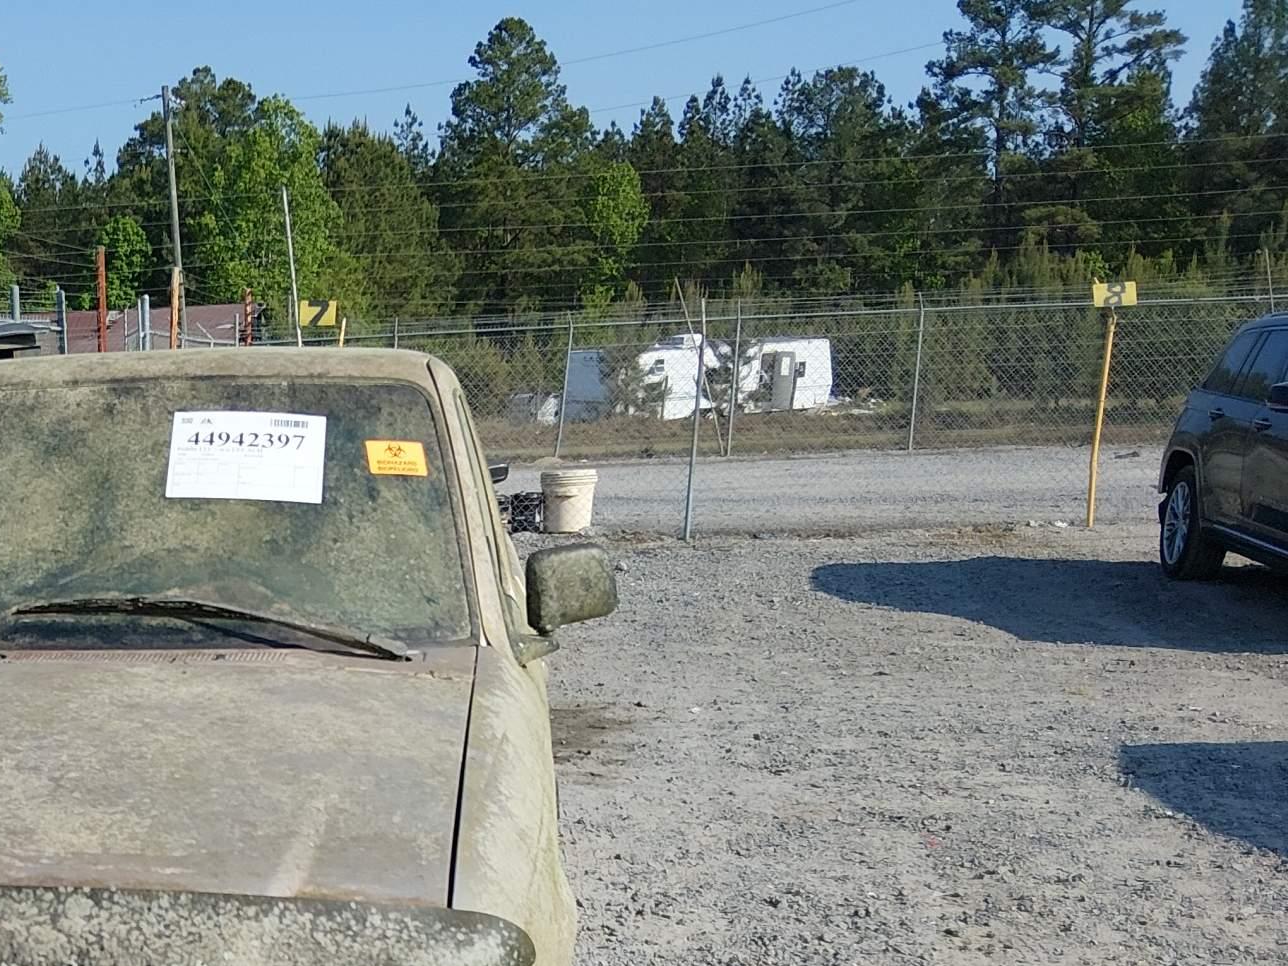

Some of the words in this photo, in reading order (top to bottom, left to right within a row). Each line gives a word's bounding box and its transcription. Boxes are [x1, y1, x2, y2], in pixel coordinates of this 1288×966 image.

[1103, 281, 1126, 306] 8
[307, 299, 329, 326] 7
[187, 431, 306, 450] 44942397
